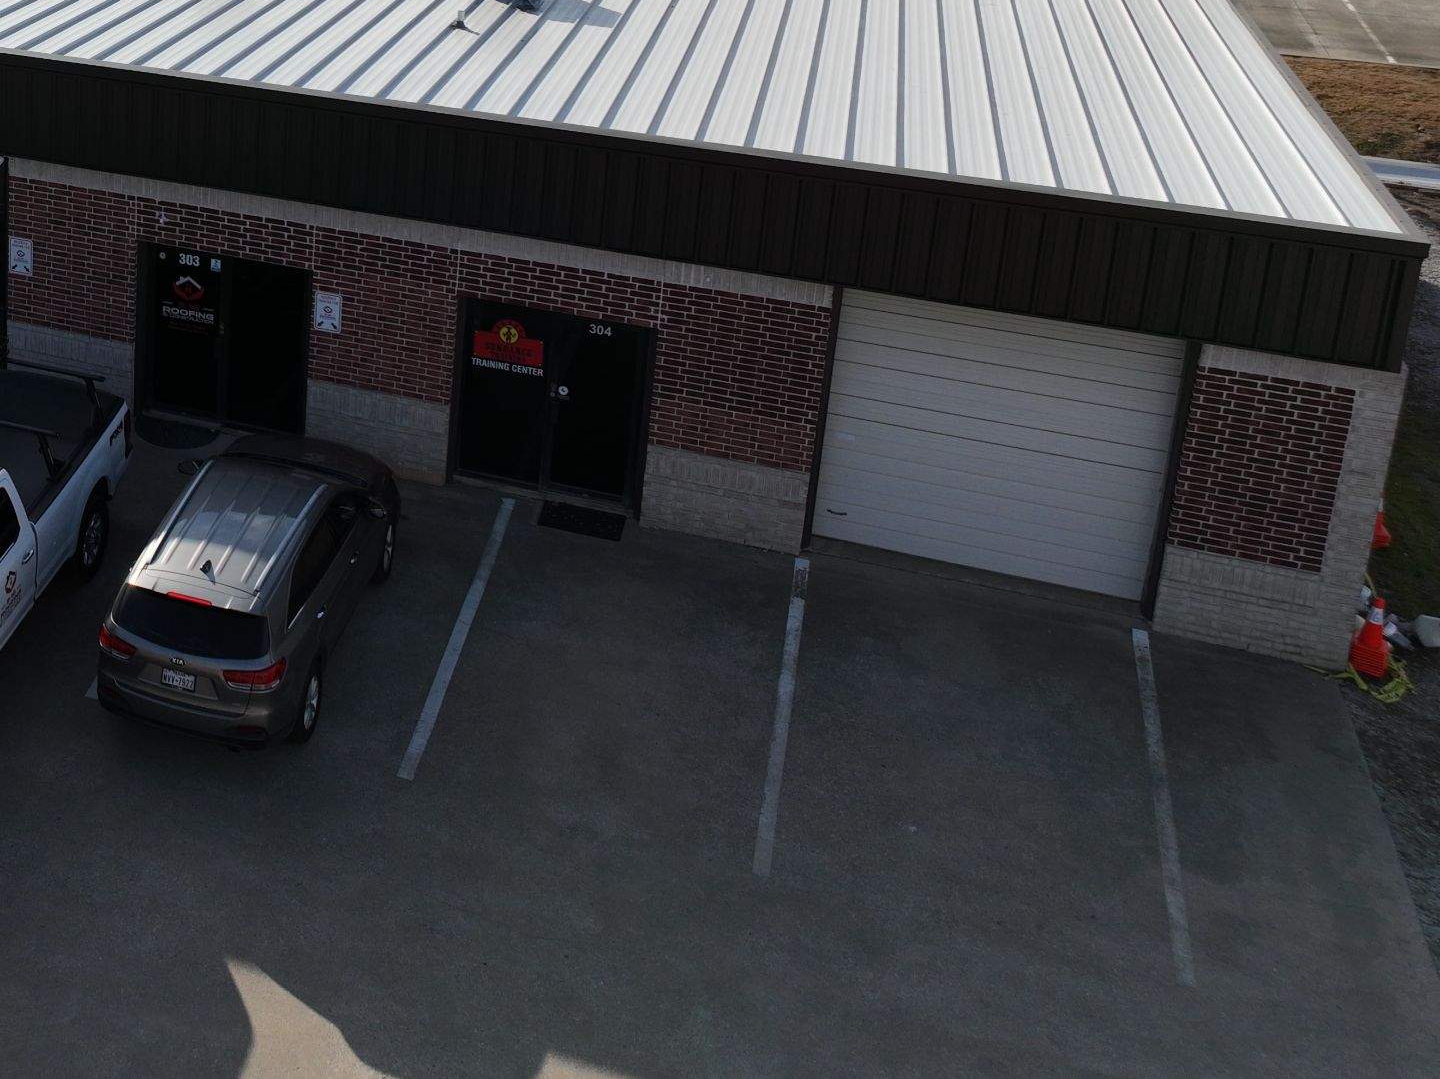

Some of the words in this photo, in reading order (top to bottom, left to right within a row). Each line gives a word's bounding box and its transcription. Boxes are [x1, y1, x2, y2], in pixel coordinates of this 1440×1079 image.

[179, 253, 200, 267] 303
[162, 306, 214, 322] ROOFING
[589, 323, 613, 337] 304
[471, 356, 510, 371] TRAINING
[512, 363, 544, 377] CENTER
[171, 657, 184, 665] KIA
